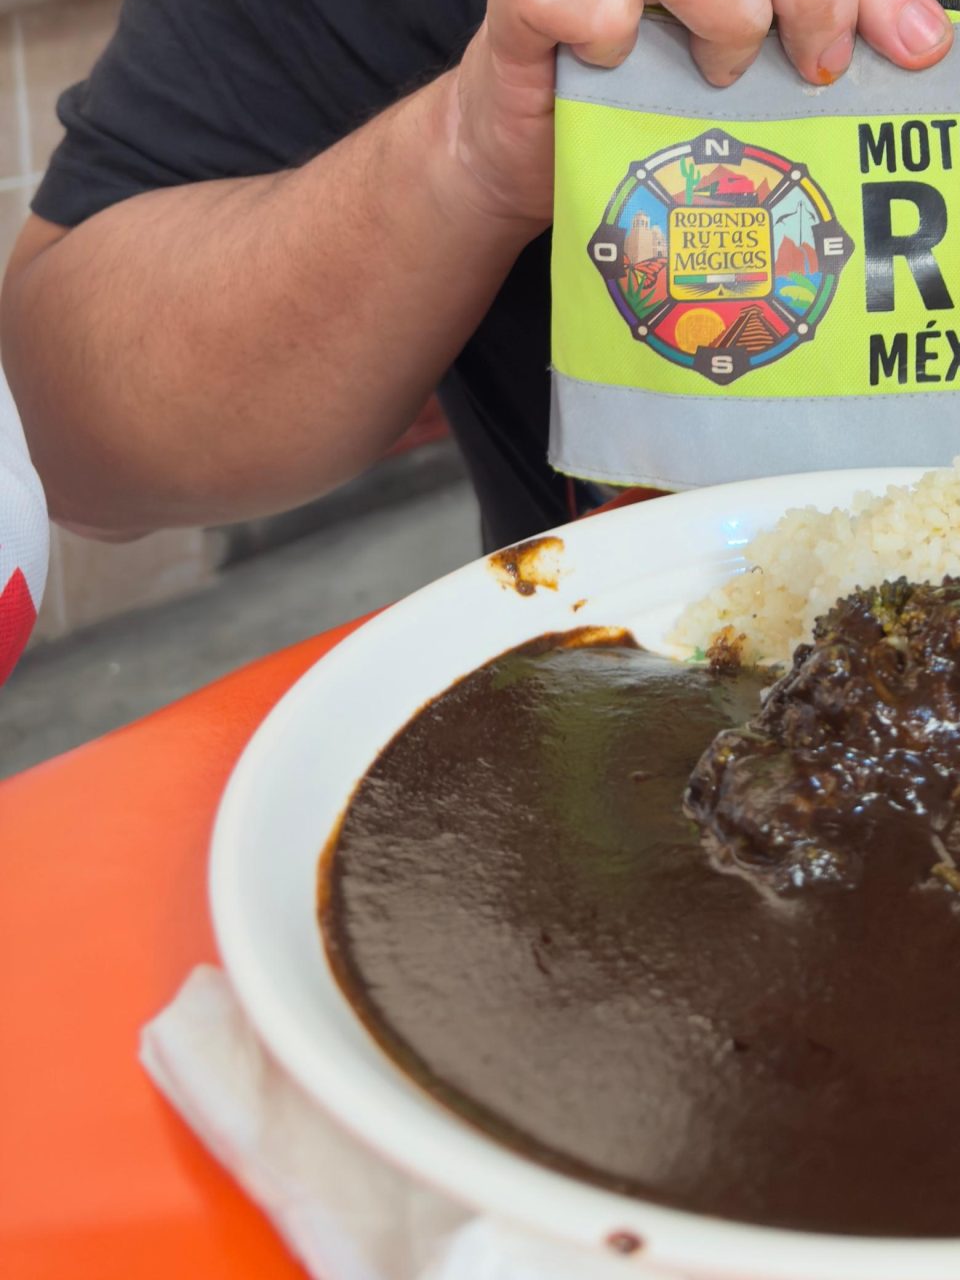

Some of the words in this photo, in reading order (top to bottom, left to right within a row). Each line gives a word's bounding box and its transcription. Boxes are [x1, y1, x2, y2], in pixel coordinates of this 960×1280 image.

[705, 138, 730, 157] N
[594, 241, 617, 261] O
[824, 236, 844, 254] E
[711, 354, 733, 373] S
